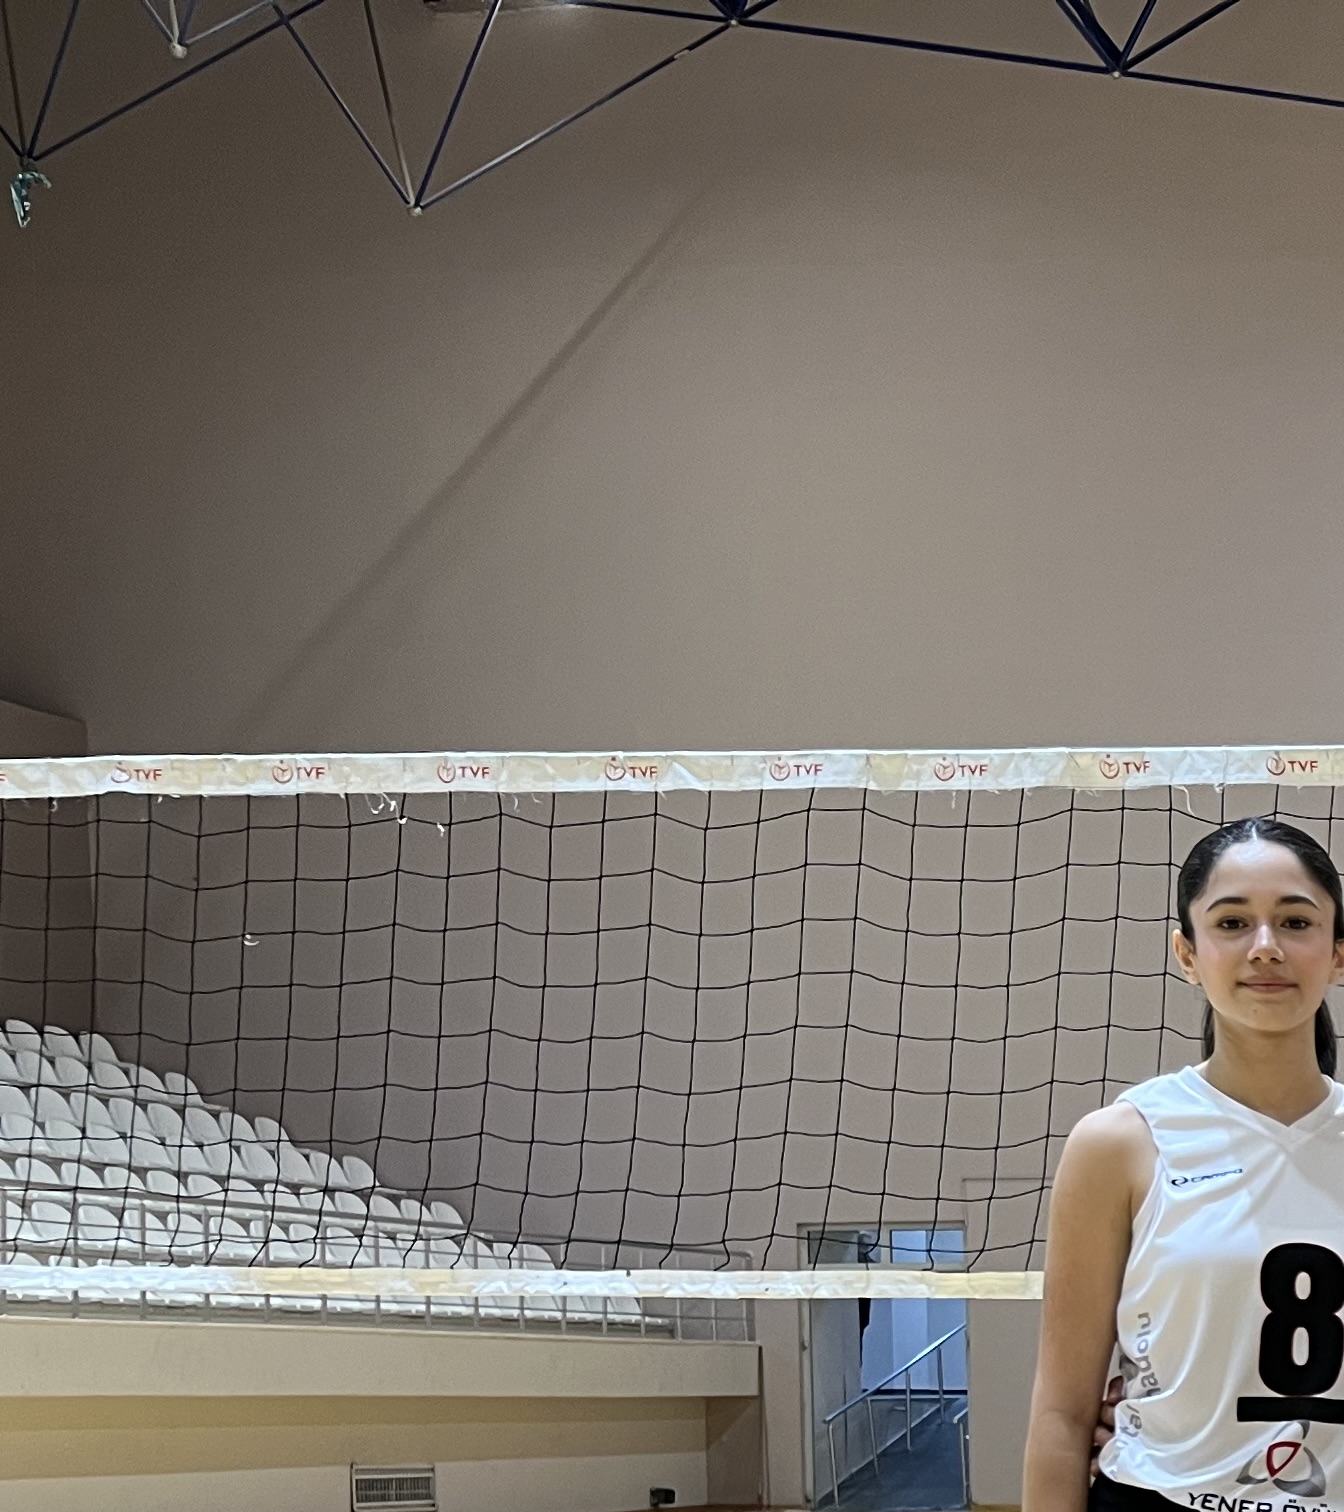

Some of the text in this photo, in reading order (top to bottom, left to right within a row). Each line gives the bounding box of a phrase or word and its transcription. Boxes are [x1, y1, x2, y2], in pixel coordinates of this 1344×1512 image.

[794, 765, 823, 777] TVF
[958, 764, 989, 777] TVF
[1124, 761, 1151, 774] TVF
[1288, 759, 1318, 771] TVF
[134, 769, 163, 781] TVF
[458, 766, 490, 778] TVF
[630, 766, 658, 778] TVF
